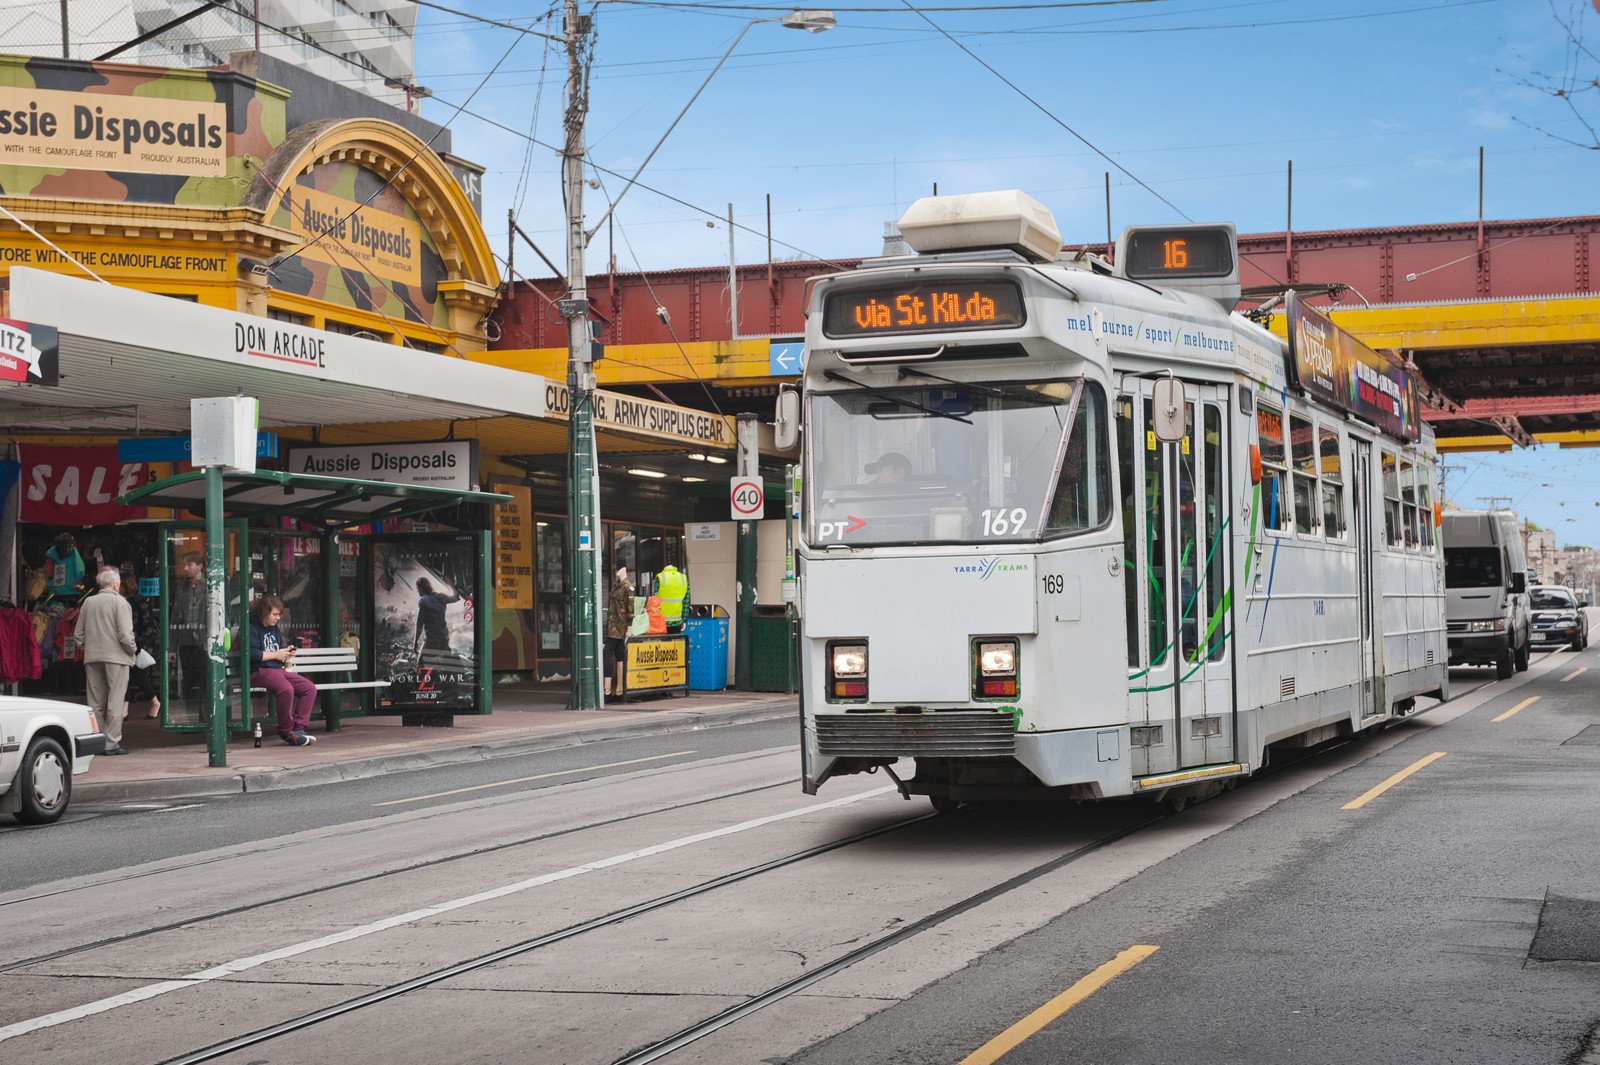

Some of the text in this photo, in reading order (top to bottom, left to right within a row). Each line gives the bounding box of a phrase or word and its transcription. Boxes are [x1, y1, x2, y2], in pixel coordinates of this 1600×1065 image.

[74, 104, 223, 155] Disposals
[4, 144, 220, 167] WITH THE CAMOUFLAGE FRONT PROUDLY AUSTRALIAN
[303, 198, 412, 259] Aussie Disposals
[35, 248, 69, 264] WITH
[72, 250, 97, 266] THE
[100, 252, 183, 271] CAMOUFLAGE
[185, 256, 228, 273] FRONT.
[1164, 239, 1188, 268] 16
[855, 291, 996, 328] via St Kilda
[235, 322, 326, 368] DON ARCADE
[1067, 315, 1133, 337] melourne
[1145, 328, 1172, 344] sport
[1184, 332, 1234, 352] melbourne
[613, 398, 650, 428] ARMY
[650, 405, 695, 438] SURPLUS
[696, 415, 725, 442] GEAR.
[303, 450, 457, 473] Aussie Disposals
[27, 463, 143, 506] SALE
[736, 490, 759, 505] 40
[981, 507, 1027, 537] 169
[998, 564, 1028, 572] TRAMS
[1042, 574, 1064, 594] 169
[636, 643, 679, 666] Aussie Disposals
[388, 674, 464, 684] WORLD WAR
[416, 667, 436, 690] Z
